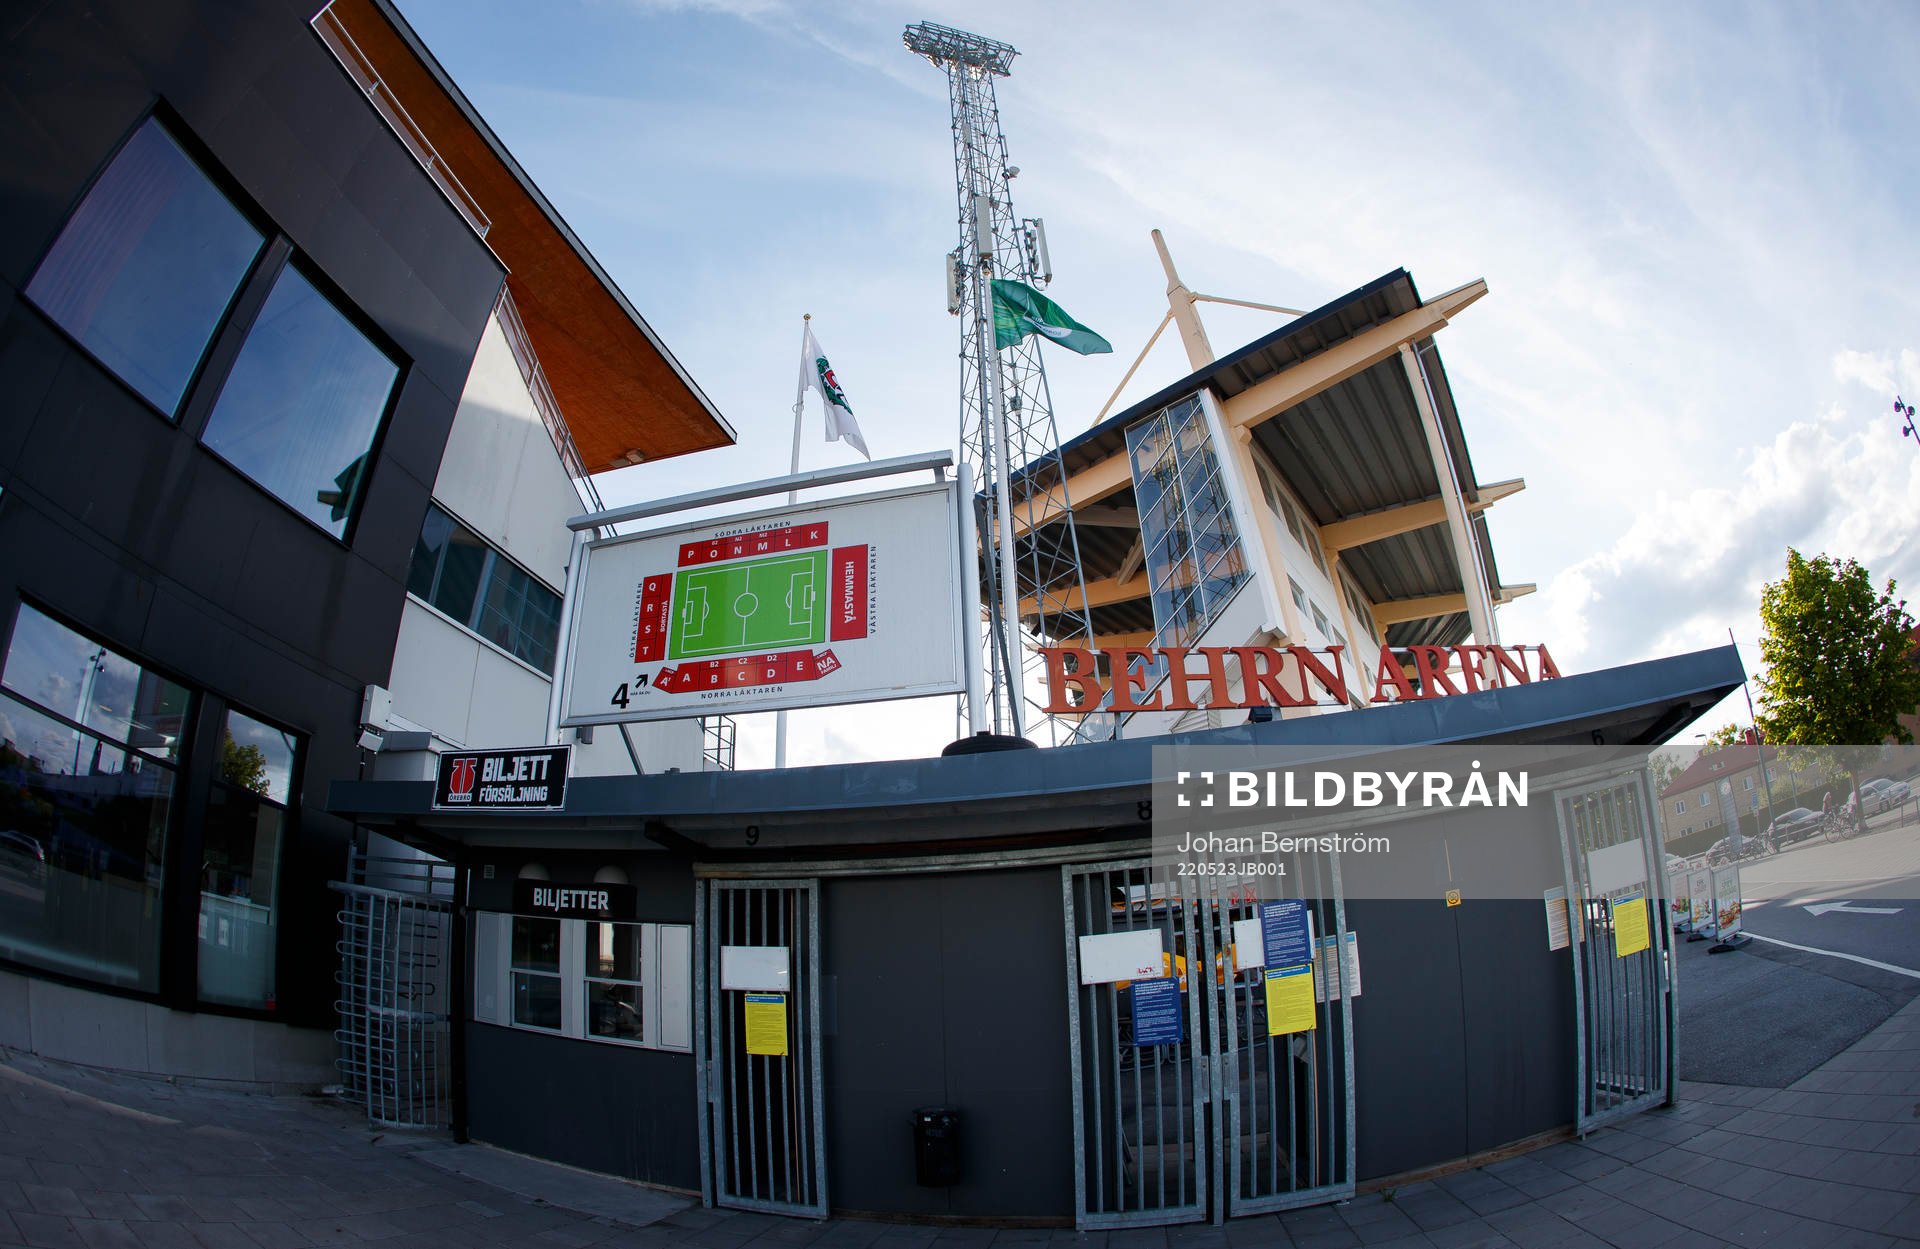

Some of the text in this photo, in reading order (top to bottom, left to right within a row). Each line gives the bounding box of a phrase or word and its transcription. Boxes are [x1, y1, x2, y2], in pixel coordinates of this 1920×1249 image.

[714, 520, 791, 538] SÖDRA LÄKTAREN
[758, 542, 768, 551] M
[786, 538, 791, 547] L
[649, 582, 656, 592] Q
[844, 561, 857, 624] HEMMASTÅ
[629, 583, 642, 658] ÖSTRA LÄKTAREN
[646, 625, 651, 634] S
[643, 646, 649, 655] T
[797, 661, 804, 671] E
[816, 656, 836, 671] NA
[683, 673, 691, 682] A
[711, 674, 718, 684] B
[738, 671, 745, 681] C
[768, 669, 775, 678] D
[1038, 643, 1561, 713] BEHRN ARENA
[611, 683, 630, 709] 4
[701, 686, 783, 699] NORRA LÄKTAREN
[482, 754, 552, 782] BILJETT
[479, 785, 548, 802] FÖRSÄLJNING
[745, 825, 759, 846] 9
[533, 887, 609, 912] BILJETTER
